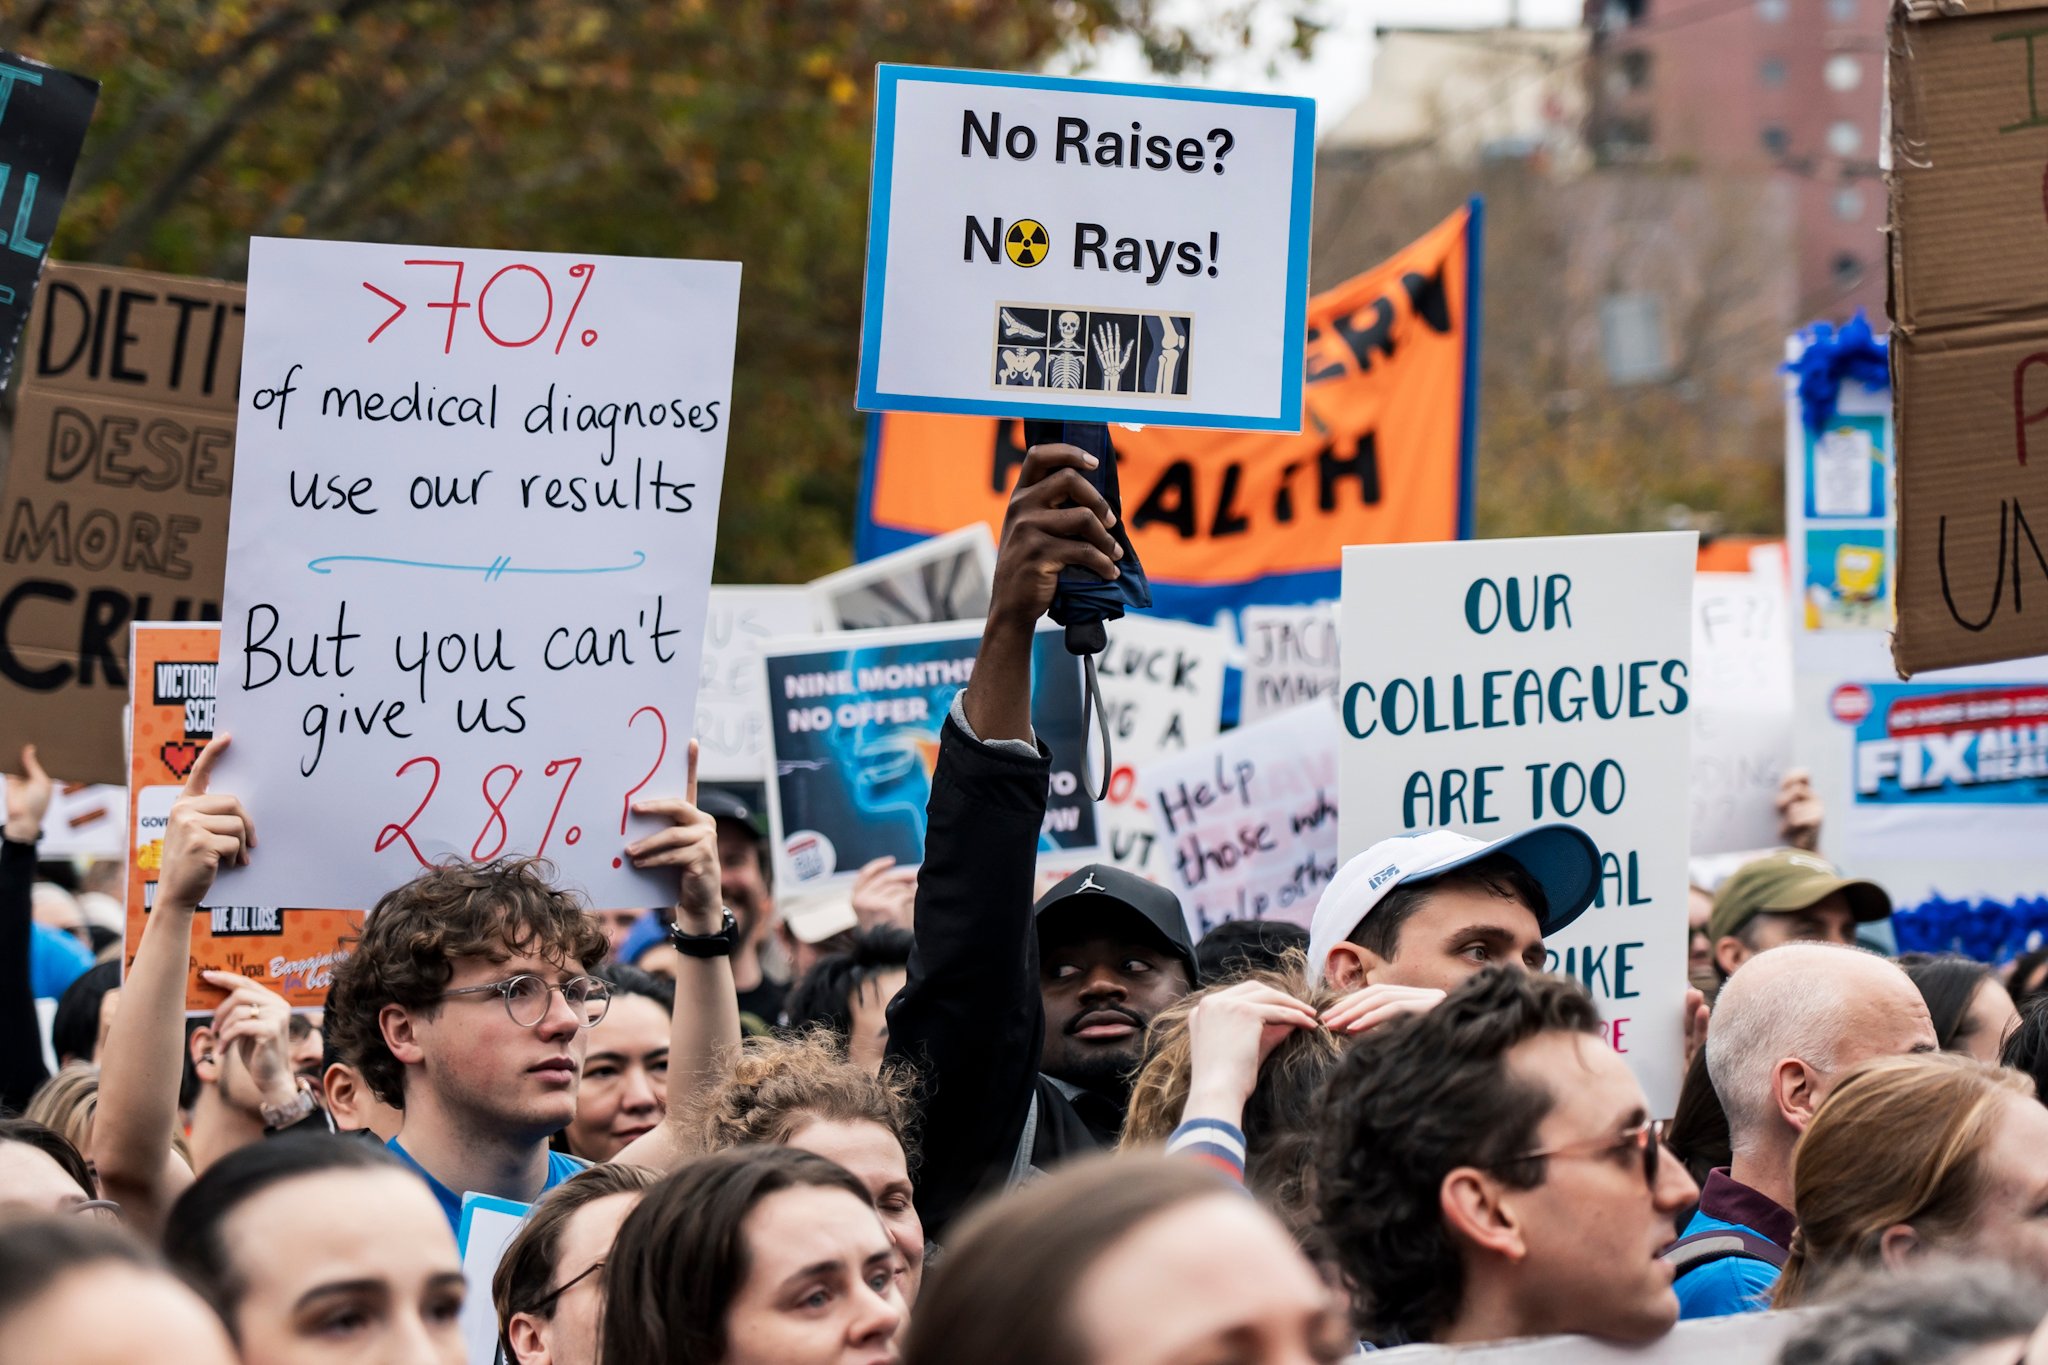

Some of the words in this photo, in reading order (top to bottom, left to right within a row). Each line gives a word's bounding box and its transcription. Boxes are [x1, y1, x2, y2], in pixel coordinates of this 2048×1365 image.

[962, 110, 1037, 161] No
[1056, 117, 1235, 175] Raise?
[1073, 223, 1220, 285] Rays!
[362, 259, 599, 355] >70%
[252, 364, 303, 430] of
[321, 381, 497, 429] medical
[524, 383, 721, 465] diagnoses
[290, 470, 379, 514] use
[409, 469, 493, 510] our
[520, 458, 697, 513] results
[3, 497, 202, 582] MORE
[1464, 573, 1573, 635] OUR
[242, 600, 362, 691] But
[395, 628, 516, 702] you
[543, 595, 682, 670] can't
[784, 670, 856, 698] NINE
[786, 705, 832, 733] NO
[836, 696, 928, 728] OFFER
[1342, 658, 1690, 740] COLLEAGUES
[300, 692, 413, 777] give
[456, 695, 527, 734] us
[1857, 732, 1978, 793] FIX
[1157, 754, 1256, 834] Help
[1402, 765, 1505, 829] ARE
[1525, 758, 1627, 821] TOO
[1175, 822, 1278, 890] those
[1594, 850, 1652, 908] AL
[230, 908, 249, 931] ALL
